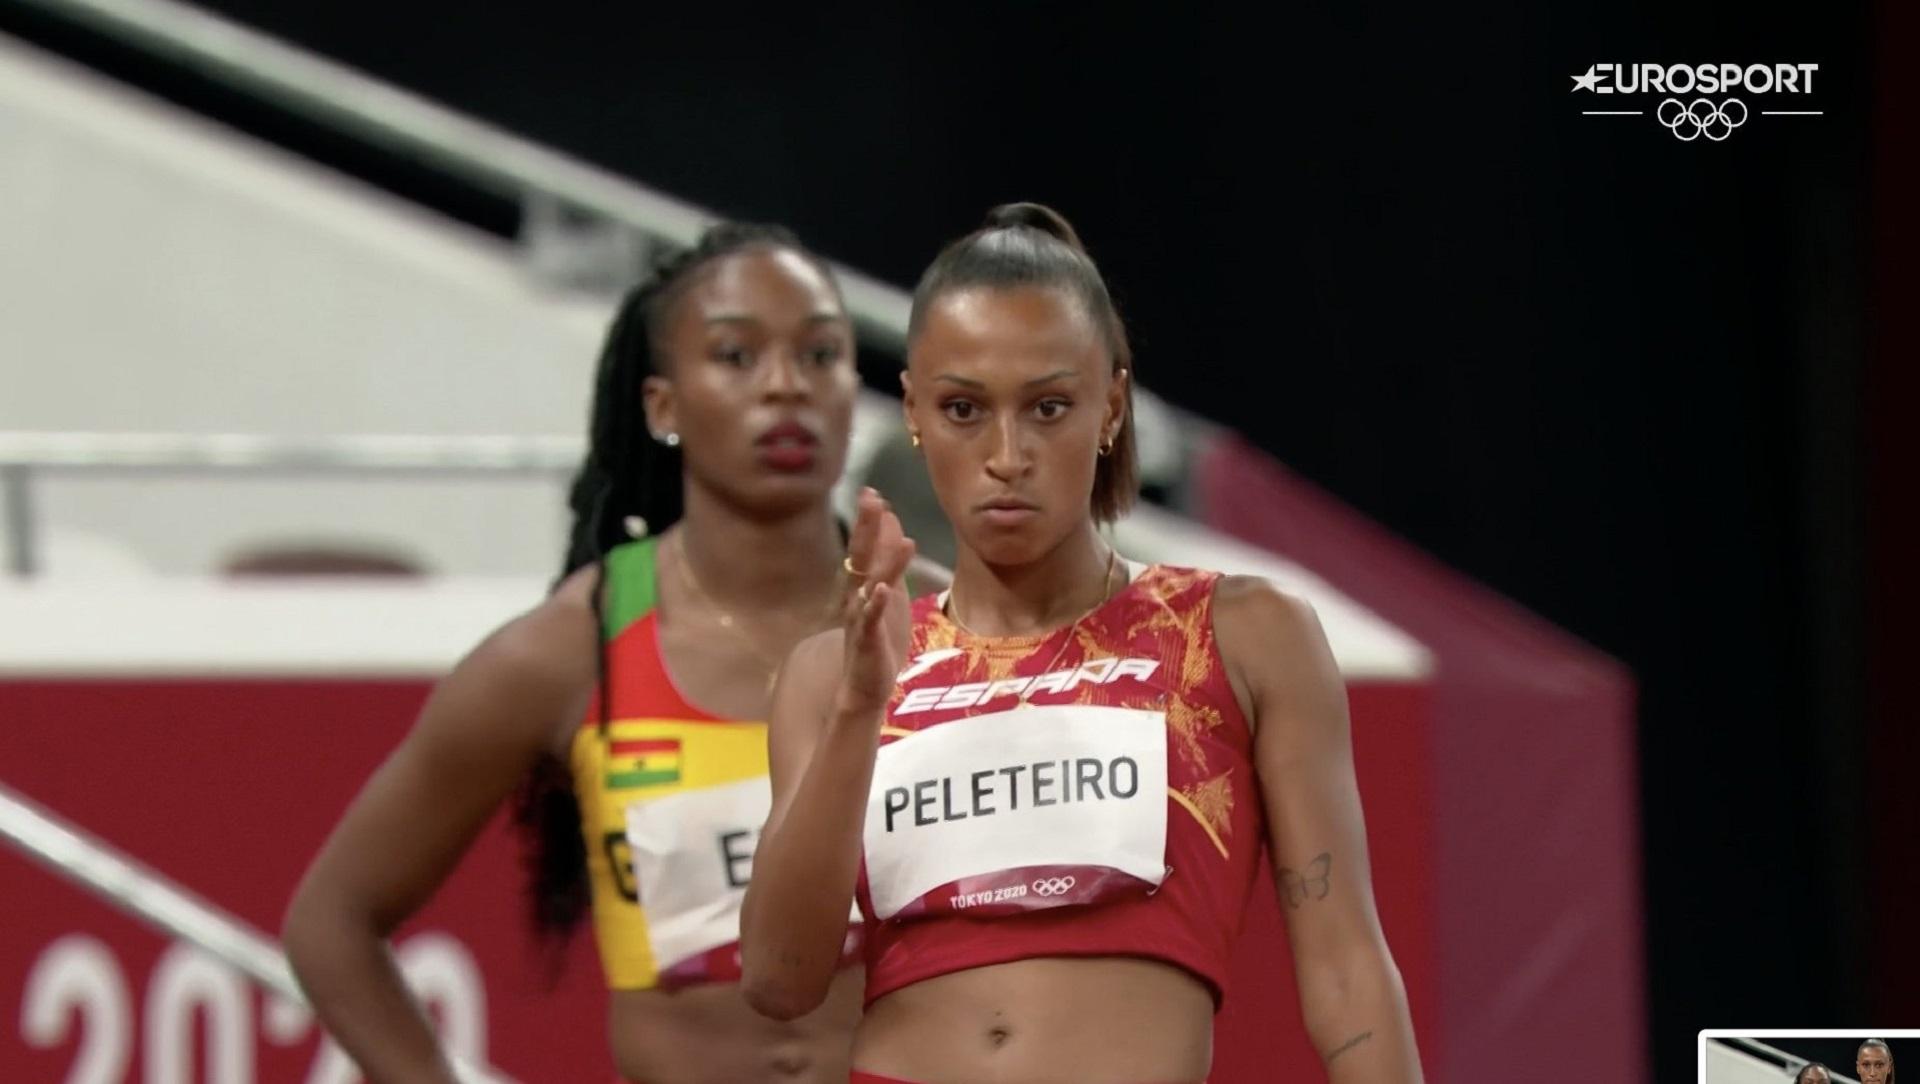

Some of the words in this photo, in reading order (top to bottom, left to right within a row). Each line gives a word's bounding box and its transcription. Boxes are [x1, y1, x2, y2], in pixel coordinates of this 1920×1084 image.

[885, 756, 1138, 832] PELETEIRO
[950, 890, 993, 909] TOKYO
[994, 884, 1028, 901] 2020
[21, 932, 487, 1084] 20
